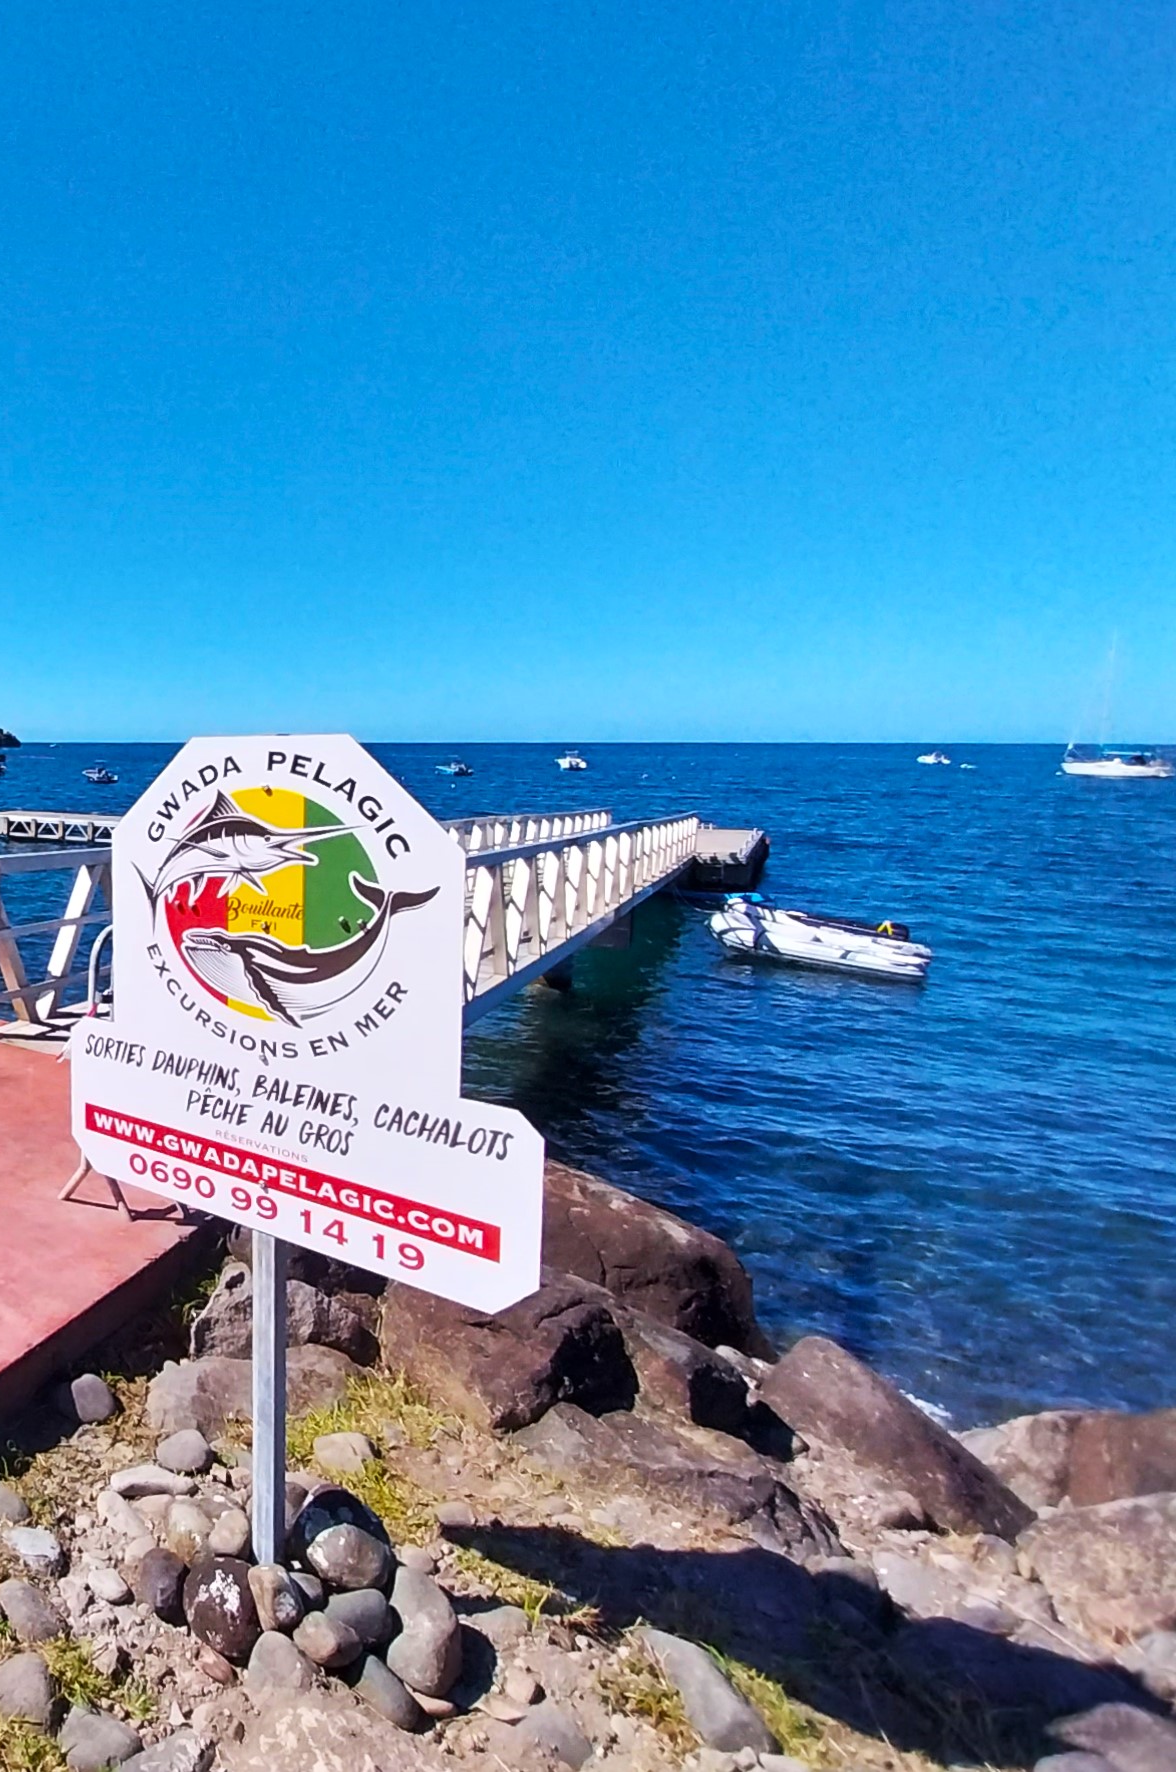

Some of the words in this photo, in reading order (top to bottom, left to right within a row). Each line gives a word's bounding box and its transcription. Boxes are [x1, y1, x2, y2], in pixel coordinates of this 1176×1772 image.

[147, 756, 242, 842] GWADA
[267, 751, 411, 859] PELAGIC
[227, 897, 304, 921] Bouillante
[146, 943, 298, 1058] EXCURSIONS
[309, 1031, 349, 1057] EN
[354, 981, 408, 1037] MER
[85, 1034, 146, 1067] SORTIES
[152, 1050, 240, 1097] DAUPHINS,
[252, 1074, 359, 1127] BALEINES,
[374, 1103, 514, 1160] CACHALOTS
[186, 1087, 254, 1126] PÊCHE
[260, 1110, 289, 1137] AU
[299, 1120, 354, 1156] GROS
[215, 1129, 308, 1163] RÉSERVATIONS
[93, 1111, 484, 1249] WWW.GWADAPELAGIC.COM
[129, 1153, 215, 1198] 0690
[231, 1187, 278, 1220] 99
[299, 1209, 348, 1246] 14
[372, 1233, 425, 1271] 19
